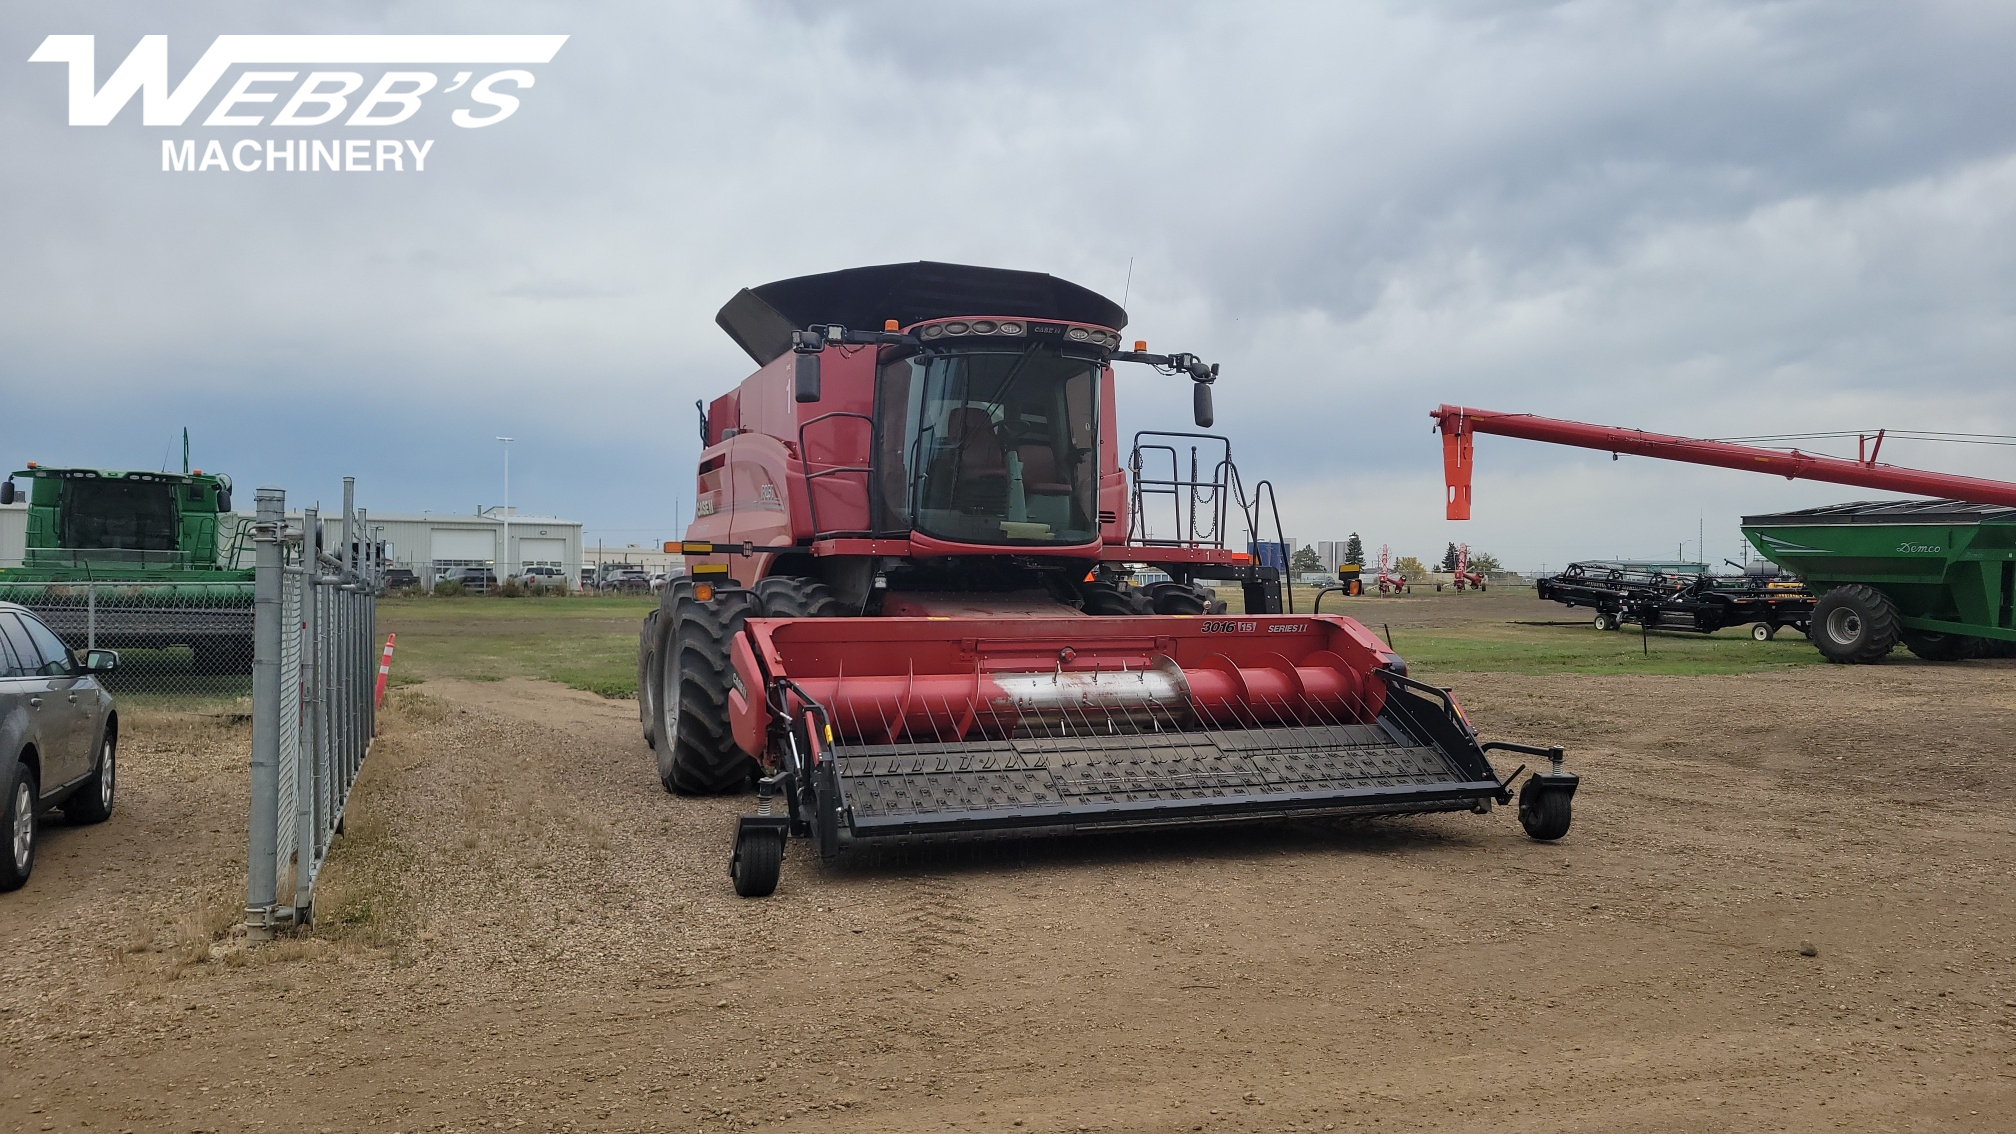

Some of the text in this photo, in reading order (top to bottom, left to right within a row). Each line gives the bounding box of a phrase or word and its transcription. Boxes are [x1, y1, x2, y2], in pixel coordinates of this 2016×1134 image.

[1896, 541, 1941, 553] Demco
[1201, 621, 1236, 633] 3016
[1267, 624, 1298, 633] SERIES
